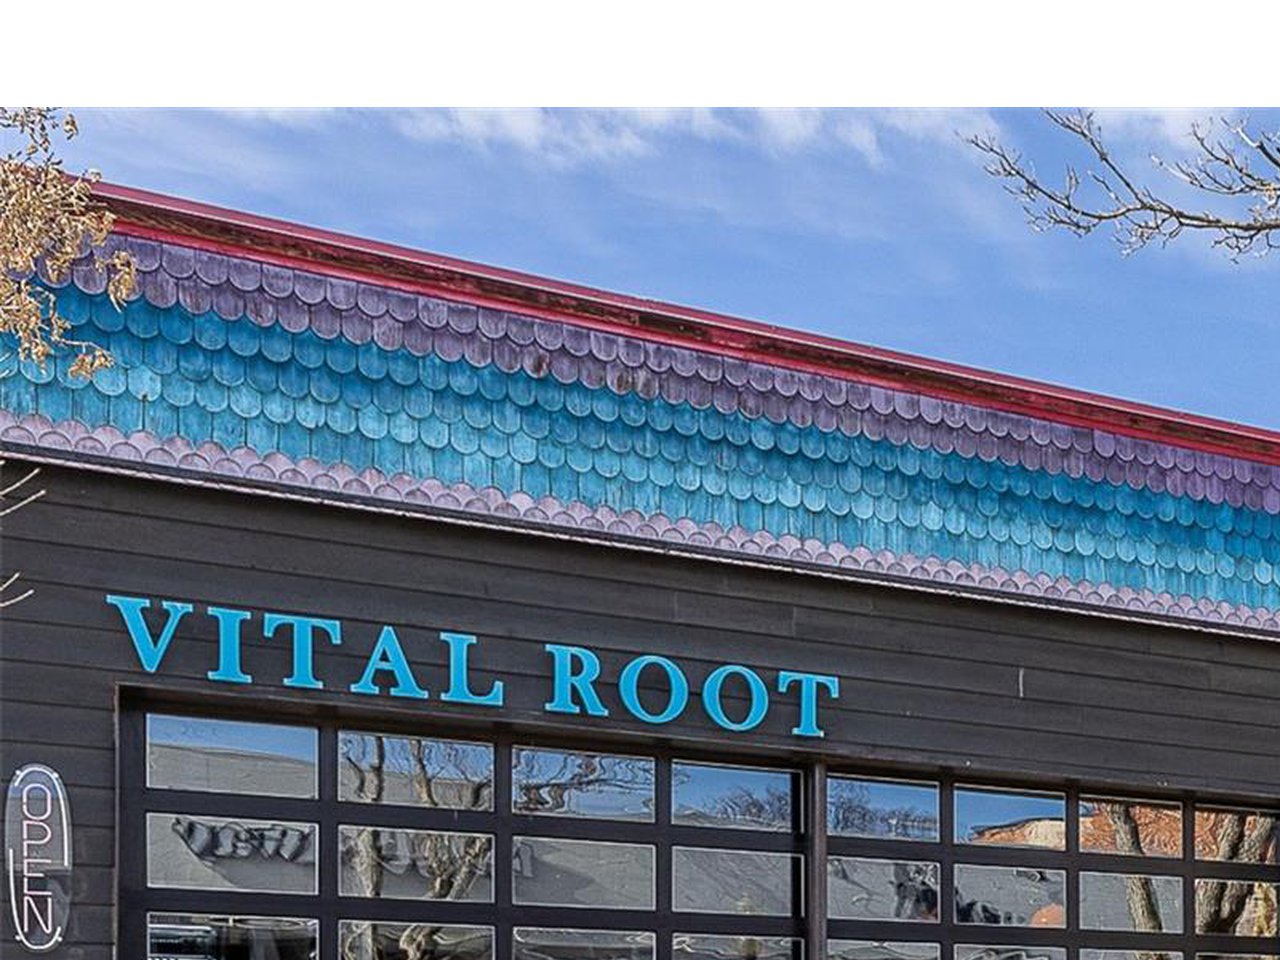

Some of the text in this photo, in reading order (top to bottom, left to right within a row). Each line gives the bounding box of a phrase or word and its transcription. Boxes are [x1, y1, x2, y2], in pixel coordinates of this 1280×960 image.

[107, 595, 840, 737] VITAL ROOT
[22, 782, 53, 934] OPEN
